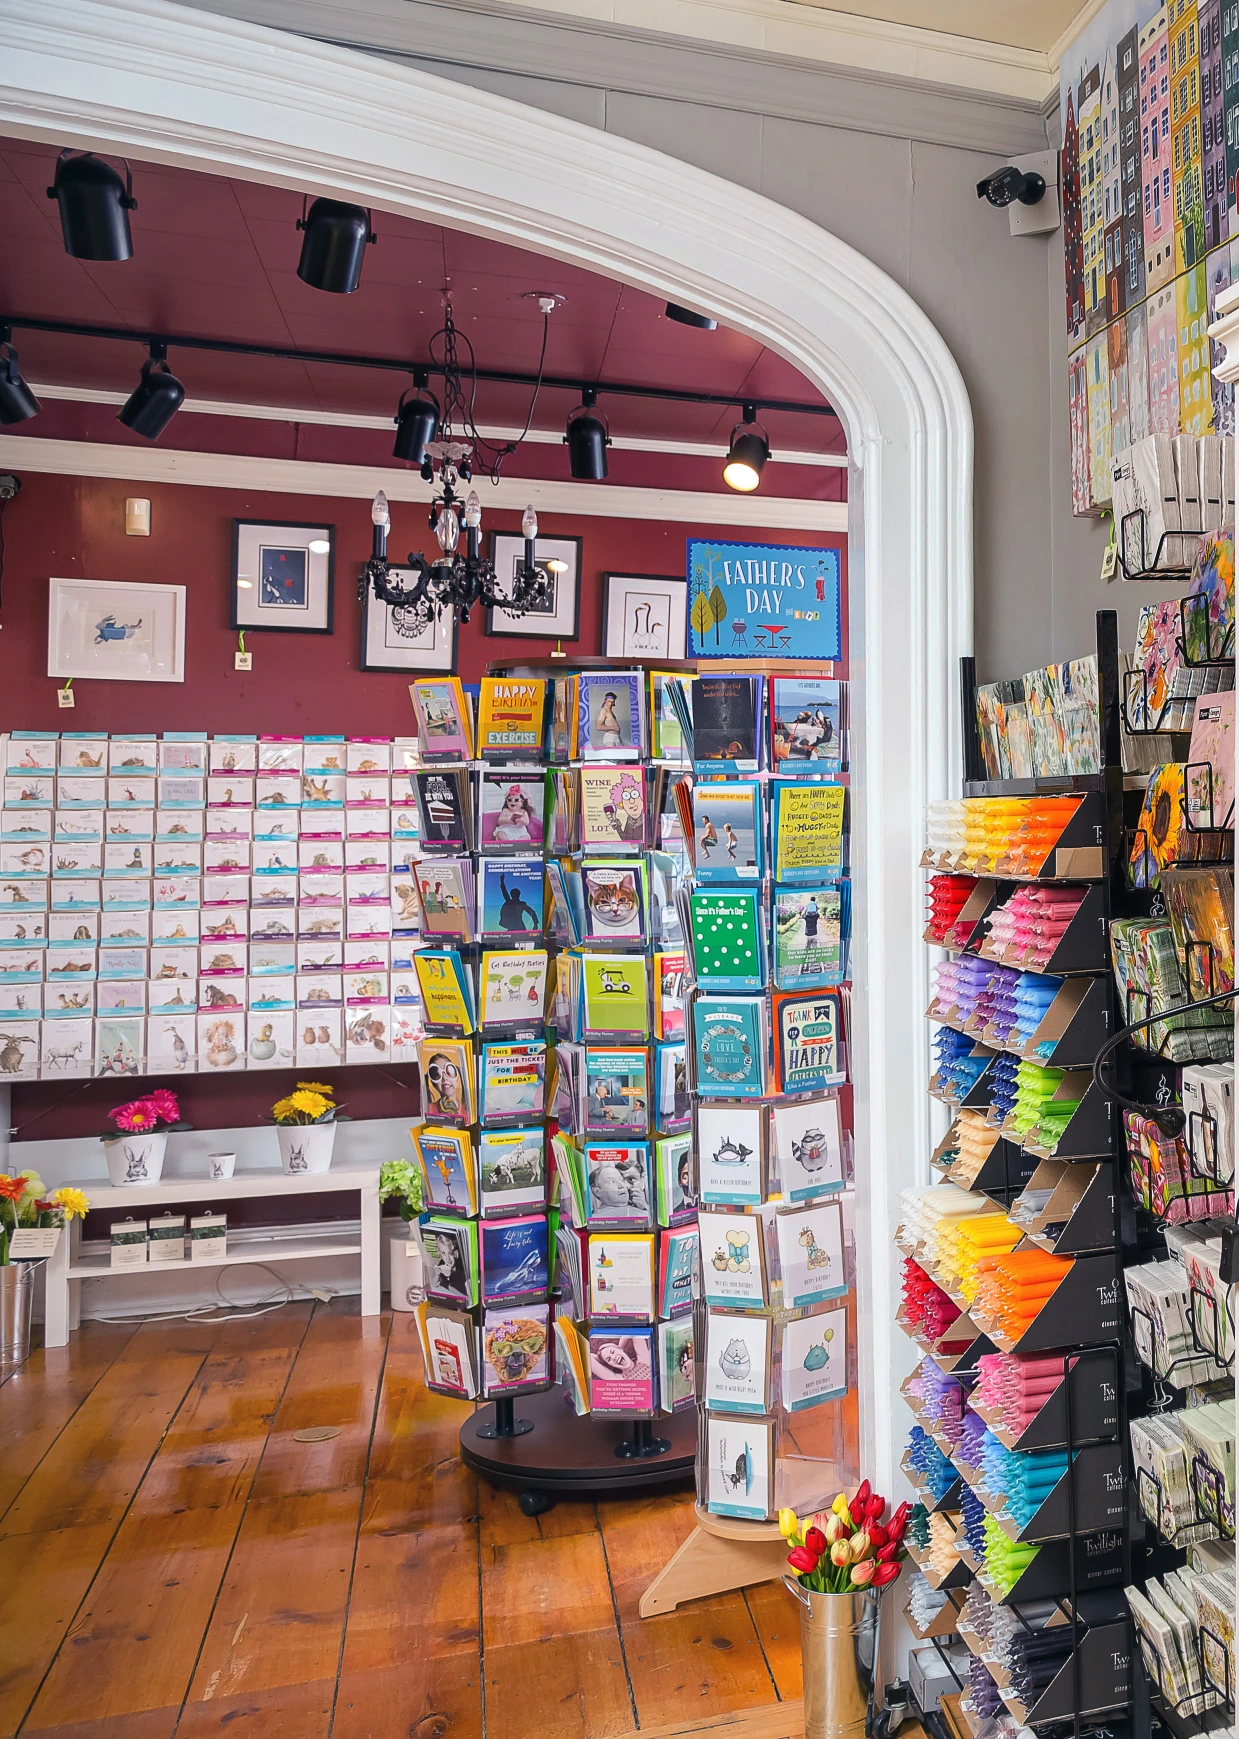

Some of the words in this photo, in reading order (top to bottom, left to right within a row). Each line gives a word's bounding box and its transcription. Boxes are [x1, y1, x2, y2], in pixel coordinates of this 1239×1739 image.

[723, 559, 806, 590] FATHER'S
[745, 588, 783, 614] DAY
[494, 685, 537, 699] HAPPY
[488, 732, 536, 744] EXERCISE
[426, 781, 451, 793] FORK
[443, 792, 454, 800] YOU
[788, 789, 801, 800] There
[810, 789, 826, 799] HAPPY
[787, 813, 809, 821] RUGGED
[695, 907, 708, 915] Since
[715, 907, 734, 915] Father's
[503, 960, 525, 968] Birthday
[707, 1013, 740, 1021] HUSBAND
[787, 1009, 812, 1024] THANK
[716, 1043, 735, 1052] LOVE
[789, 1044, 834, 1070] HAPPY
[497, 1076, 532, 1084] BIRTHDAY
[680, 1254, 687, 1263] IS
[815, 1274, 831, 1283] BIRTHDAY
[673, 1291, 686, 1299] THE
[1083, 1533, 1123, 1553] Twilight
[1087, 1569, 1103, 1578] dinner
[1103, 1567, 1122, 1575] candles
